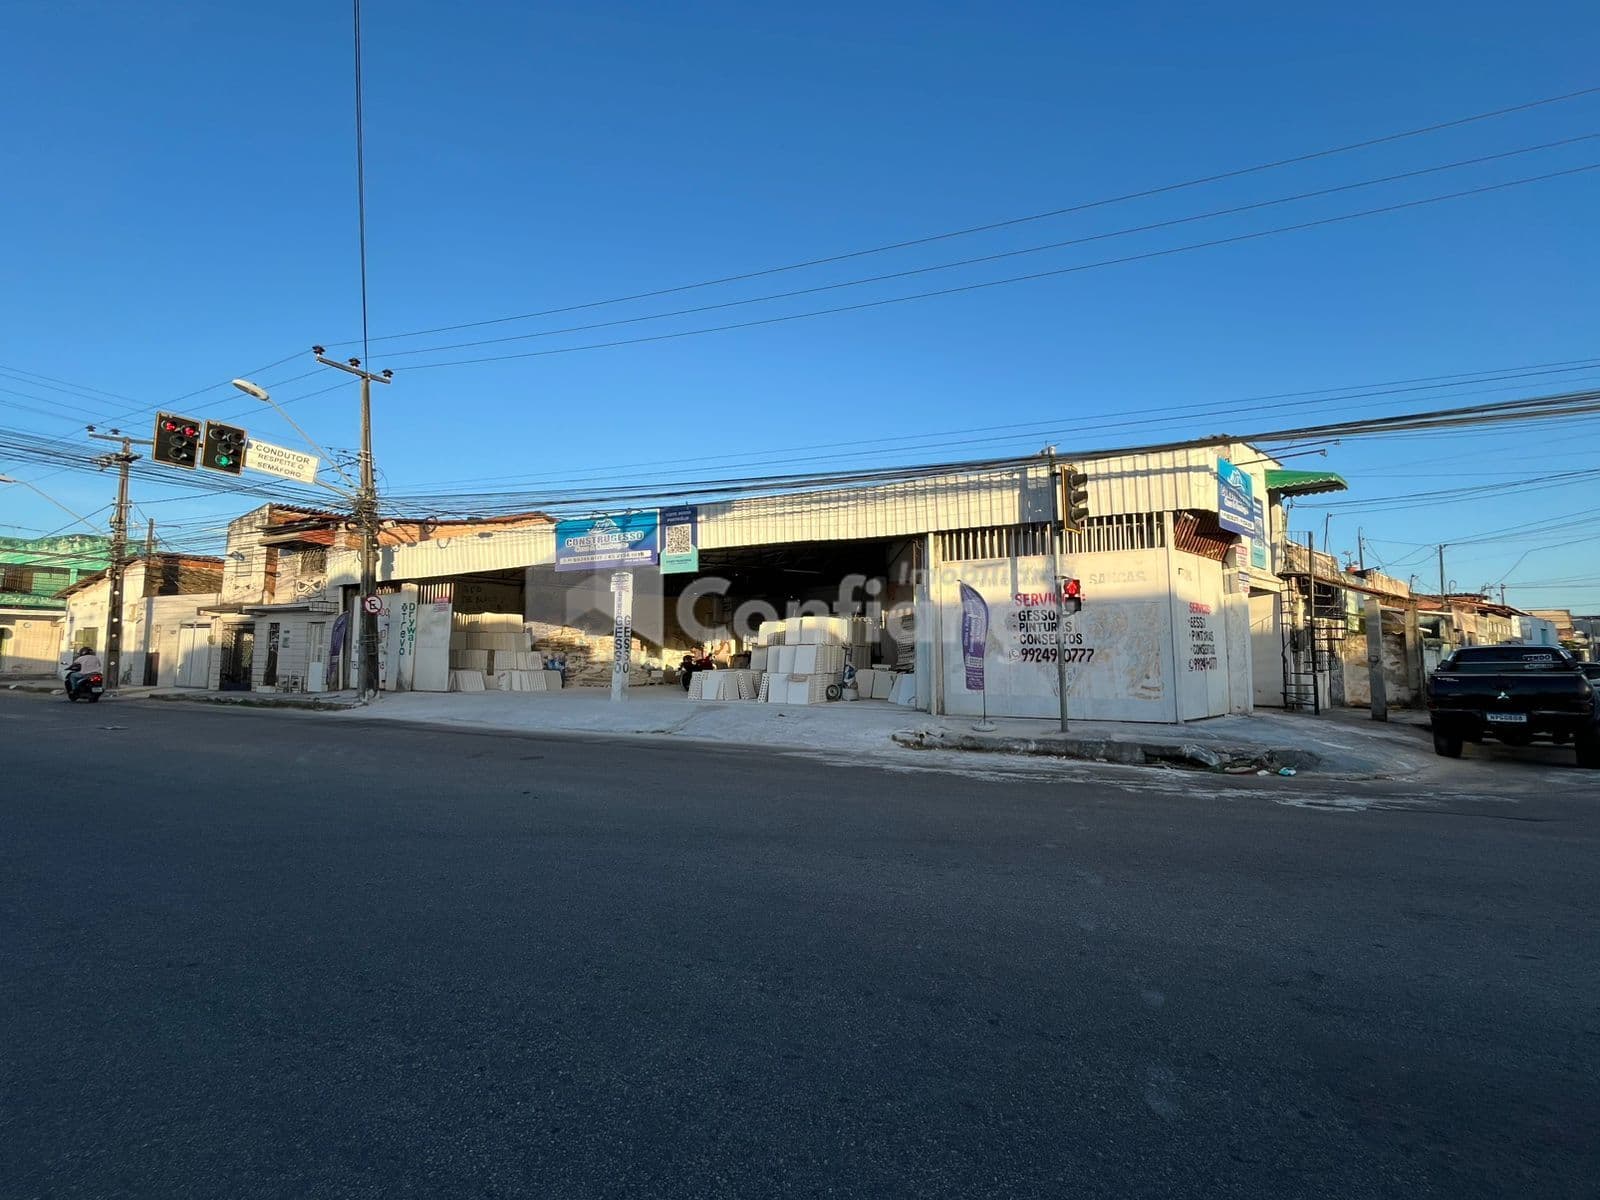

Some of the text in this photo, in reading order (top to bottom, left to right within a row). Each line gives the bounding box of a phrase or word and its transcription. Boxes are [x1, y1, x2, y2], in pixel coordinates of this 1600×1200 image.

[255, 443, 311, 465] CONDUTOR
[257, 453, 297, 469] RESPEITE
[566, 531, 643, 546] CONSTRUGESSO
[1018, 610, 1056, 621] GESSO
[1019, 621, 1073, 632] PINTURS
[615, 615, 623, 674] GESSO
[622, 615, 631, 674] GESSO
[1019, 633, 1083, 645] CONSETOS
[1021, 647, 1095, 663] 992490777
